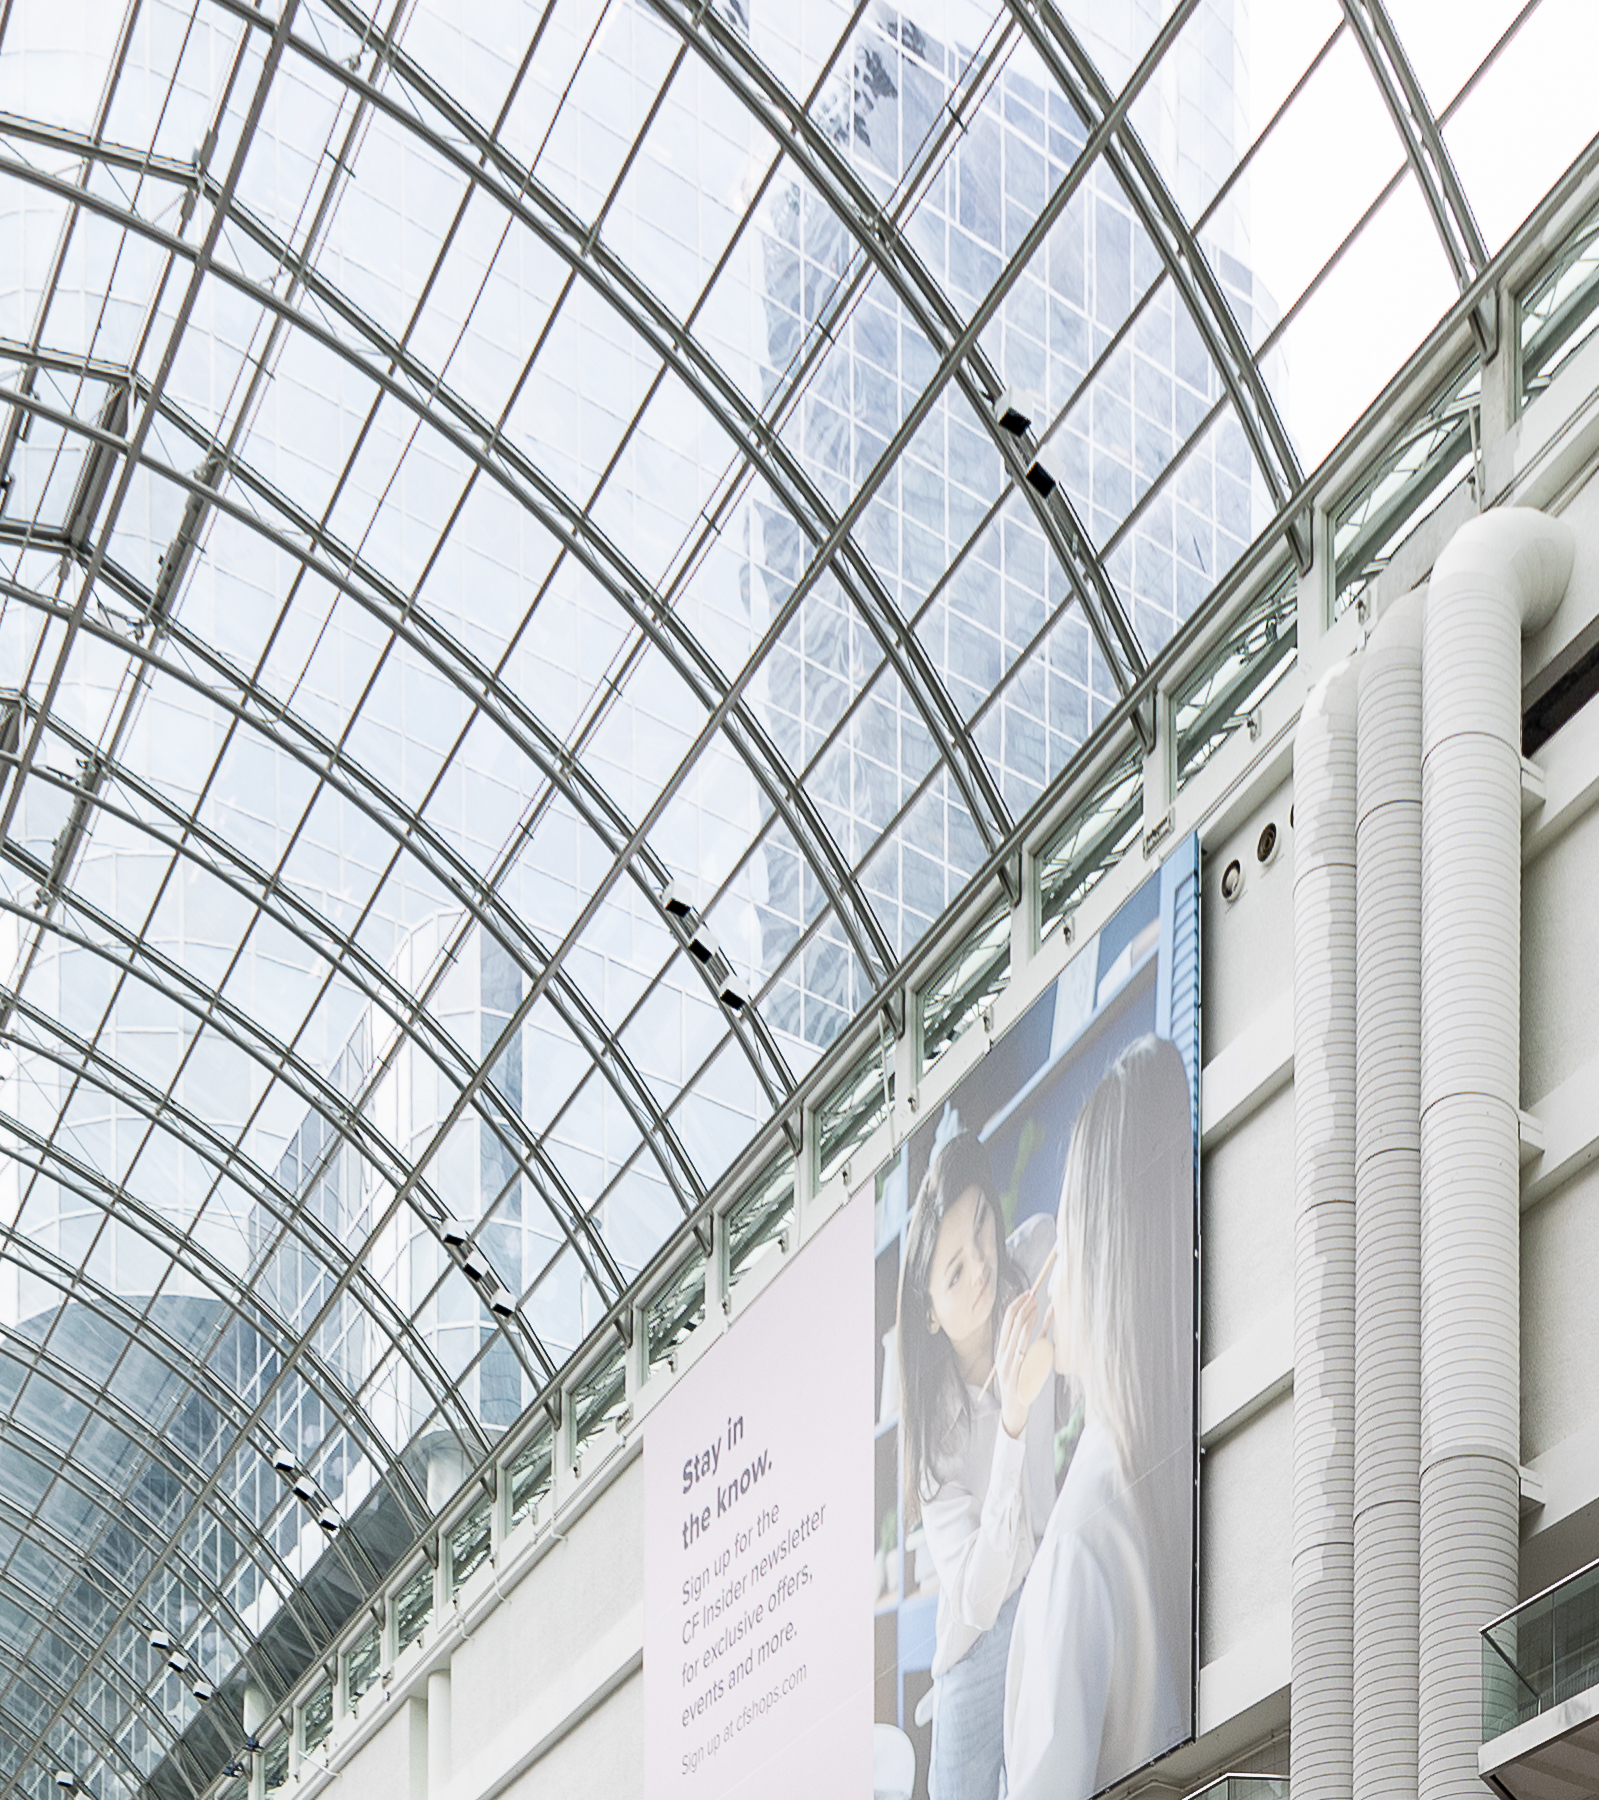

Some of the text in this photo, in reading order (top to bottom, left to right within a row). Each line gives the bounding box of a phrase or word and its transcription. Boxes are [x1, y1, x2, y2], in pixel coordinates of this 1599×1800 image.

[682, 1415, 743, 1494] Stay in
[682, 1448, 772, 1550] the know.
[682, 1503, 779, 1606] Sign up for the
[682, 1503, 826, 1645] CF Insider newsletter
[682, 1564, 813, 1688] for exclusive offers,
[682, 1621, 798, 1728] events and more.
[682, 1663, 807, 1776] Sign up at cfshops.com
